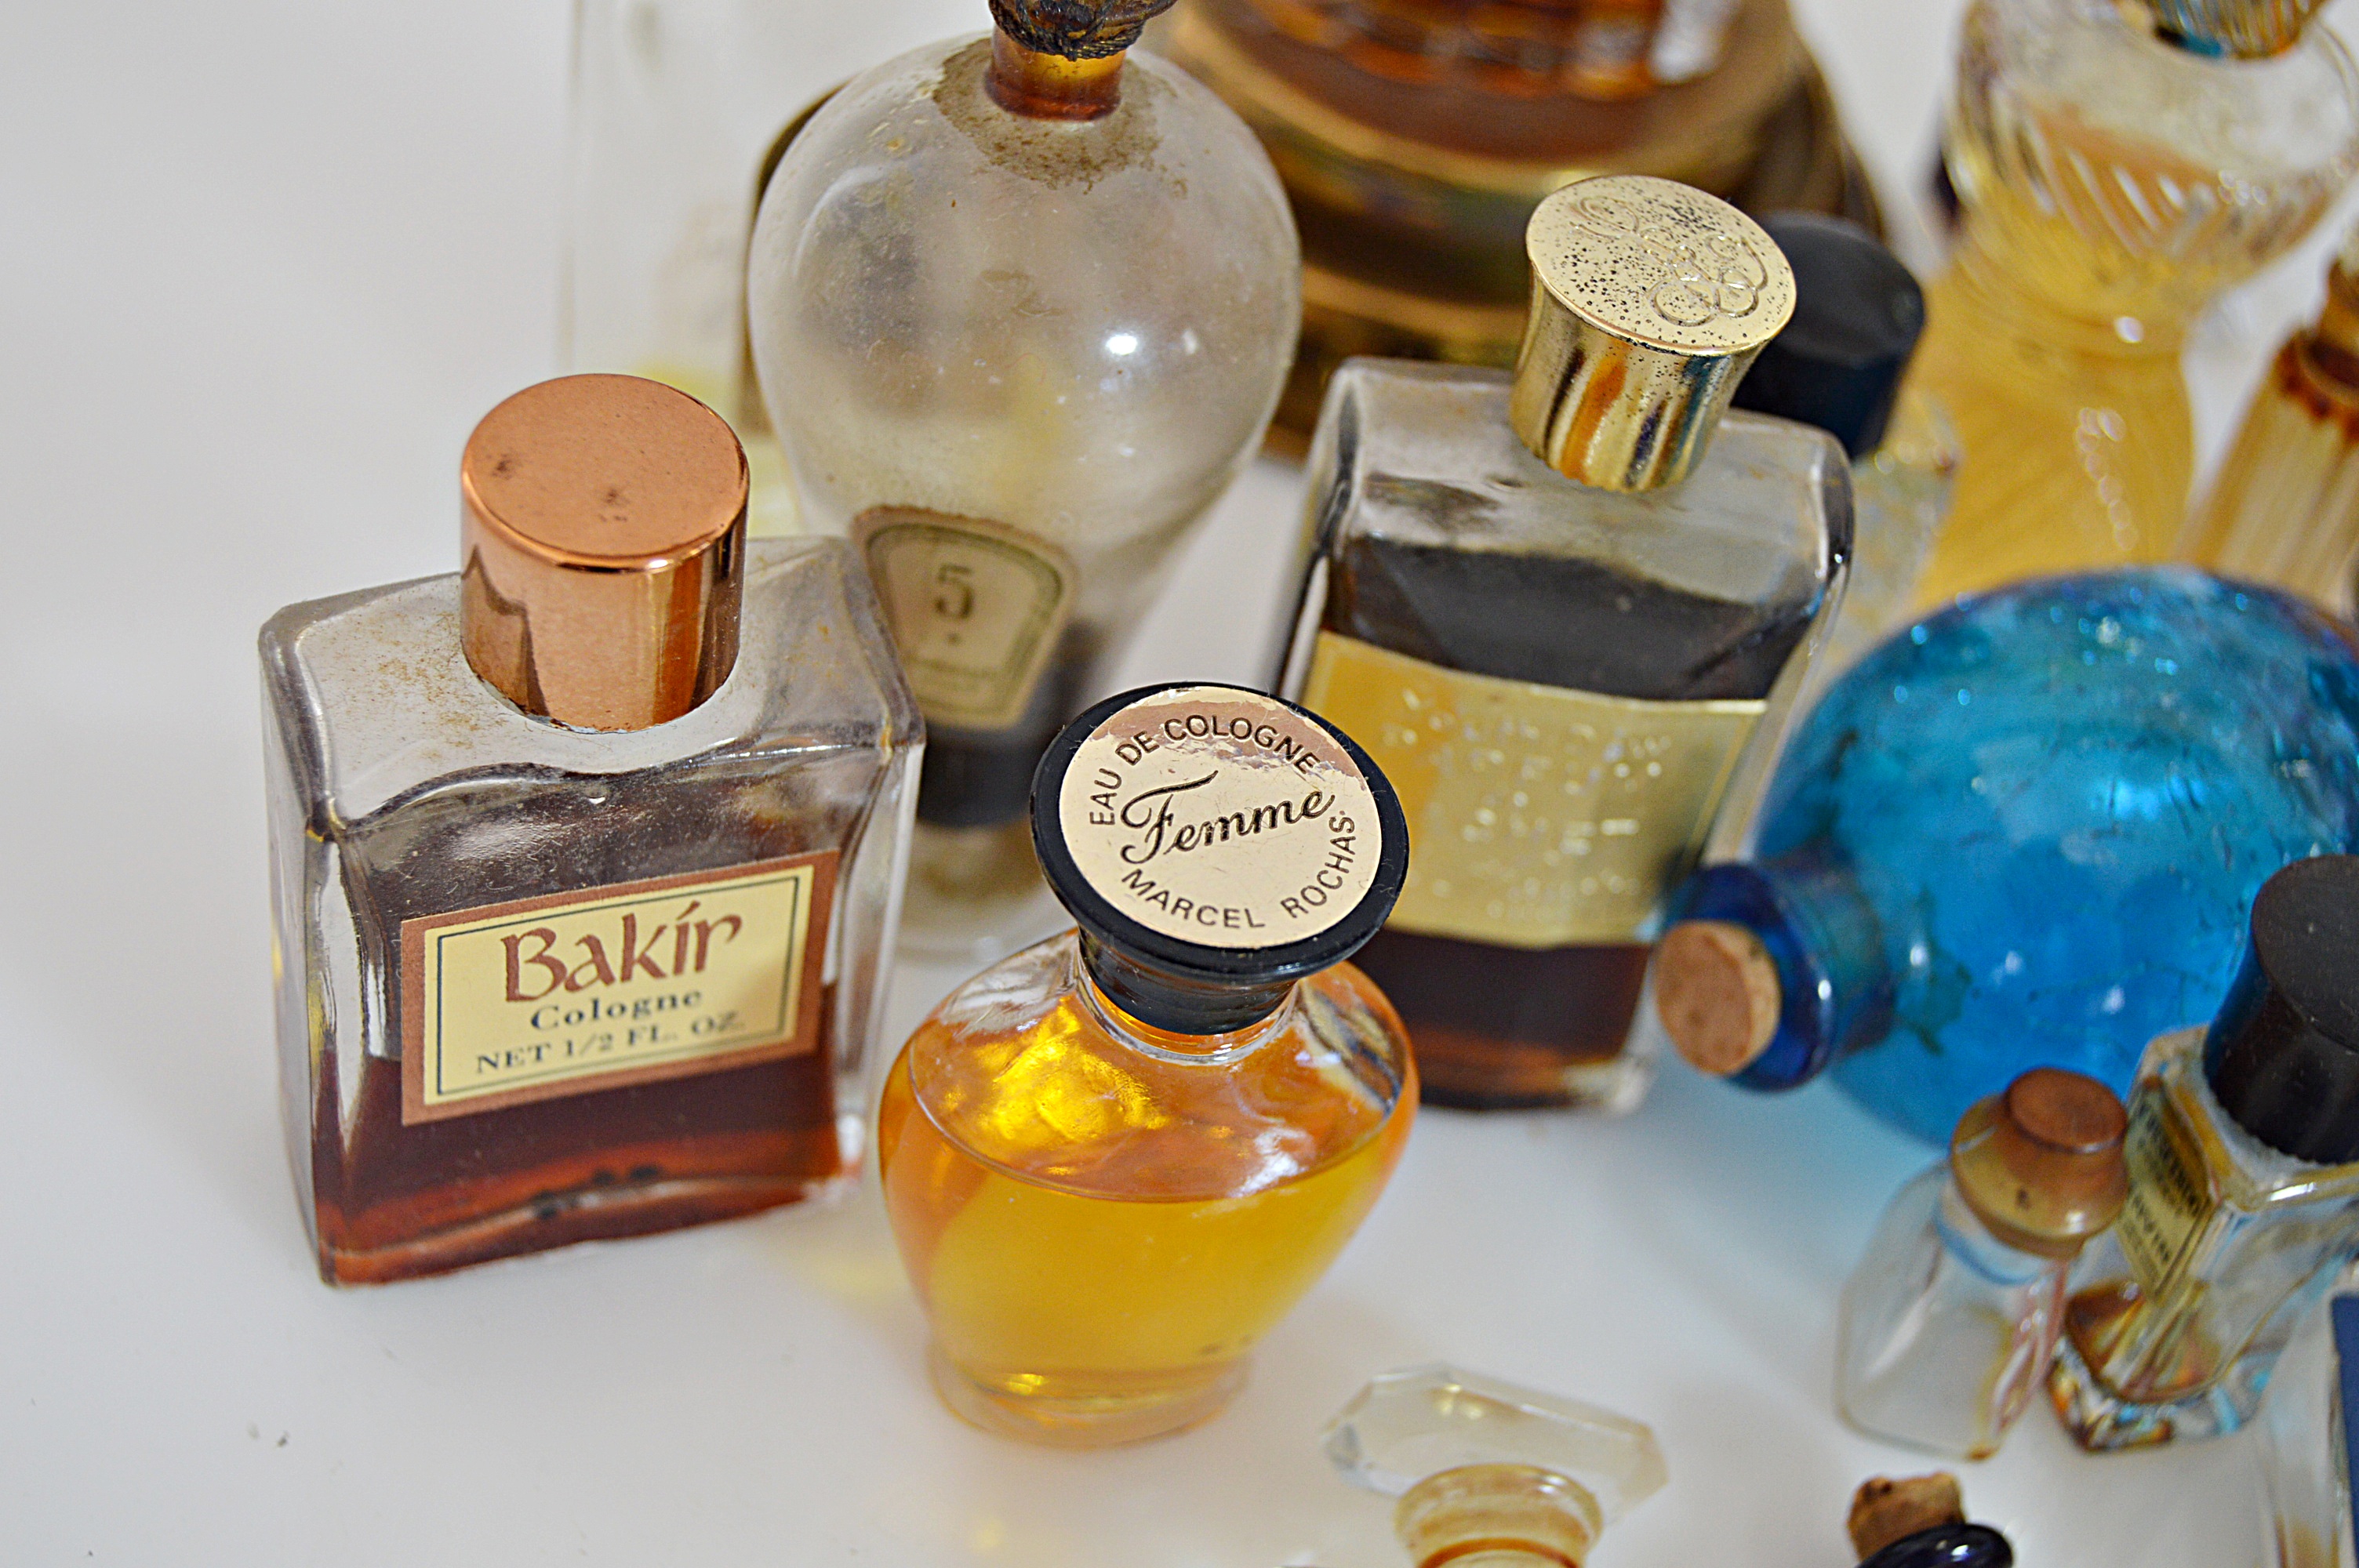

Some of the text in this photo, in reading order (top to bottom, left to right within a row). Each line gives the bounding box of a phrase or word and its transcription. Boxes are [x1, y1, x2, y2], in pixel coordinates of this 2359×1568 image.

[935, 563, 973, 619] 5
[1089, 714, 1321, 826] EAU DE COLOGNE
[1120, 770, 1335, 865] Femme
[1121, 869, 1266, 928] MARCEL
[530, 990, 702, 1031] Cologne
[475, 1044, 551, 1074] NET
[563, 1032, 614, 1057] 1/2
